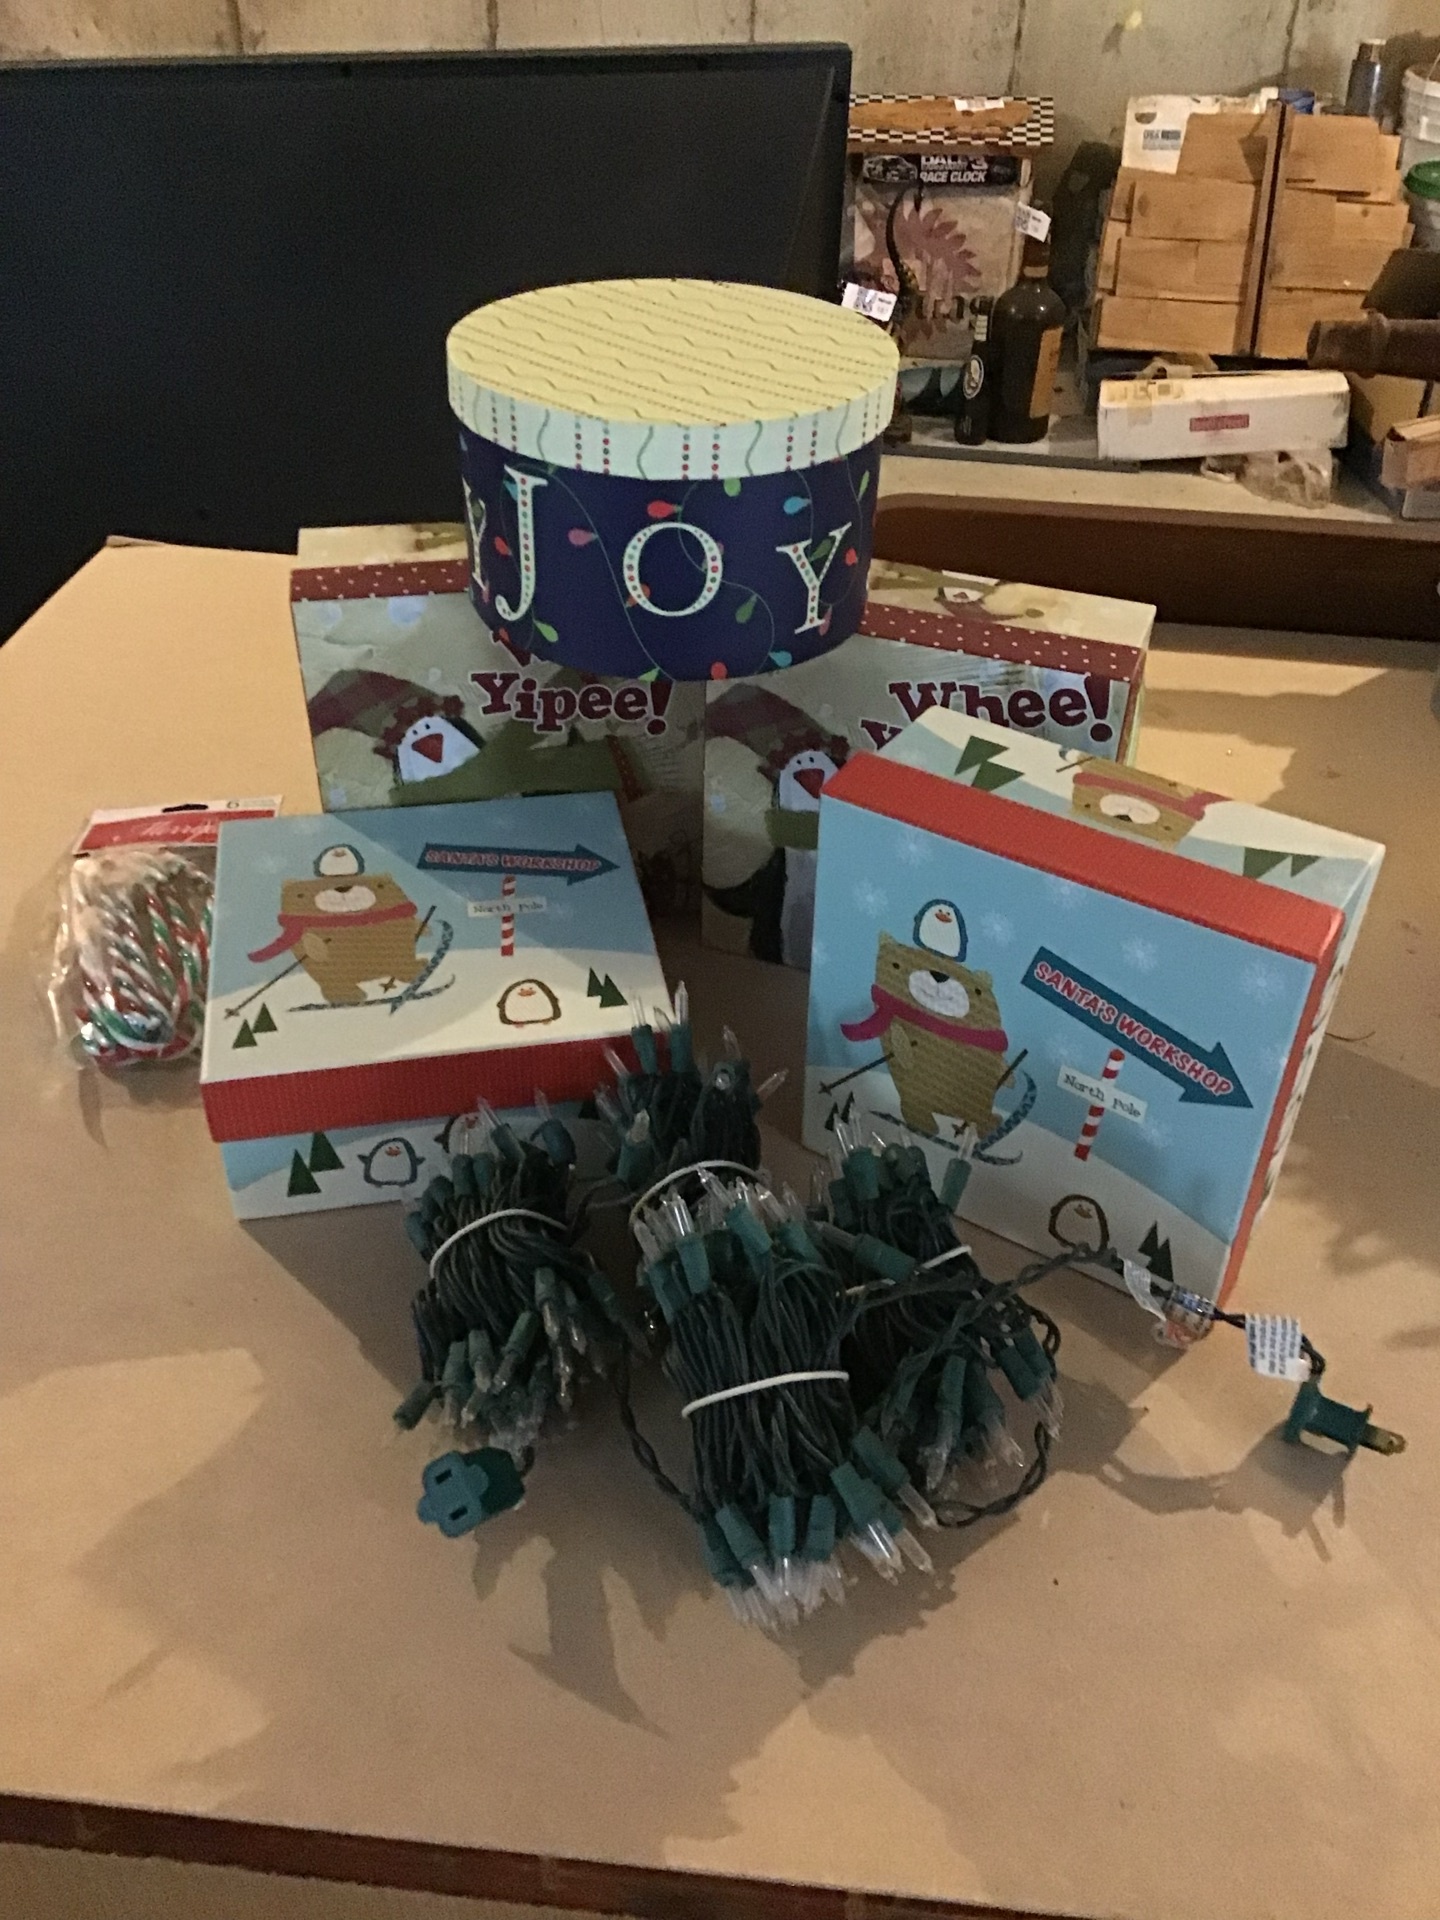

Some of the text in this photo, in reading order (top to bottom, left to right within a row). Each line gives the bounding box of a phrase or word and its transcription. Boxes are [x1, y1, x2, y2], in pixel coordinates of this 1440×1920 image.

[920, 171, 986, 183] RACE CLOCK
[495, 464, 852, 634] JOY
[470, 671, 674, 736] Yipee!
[888, 675, 1113, 742] Whee!
[425, 850, 601, 872] SANTA'S WORKSHOP
[472, 901, 544, 914] North Pole
[1034, 961, 1234, 1096] SANTA'S WORKSHOP
[1064, 1073, 1142, 1118] North Pole
